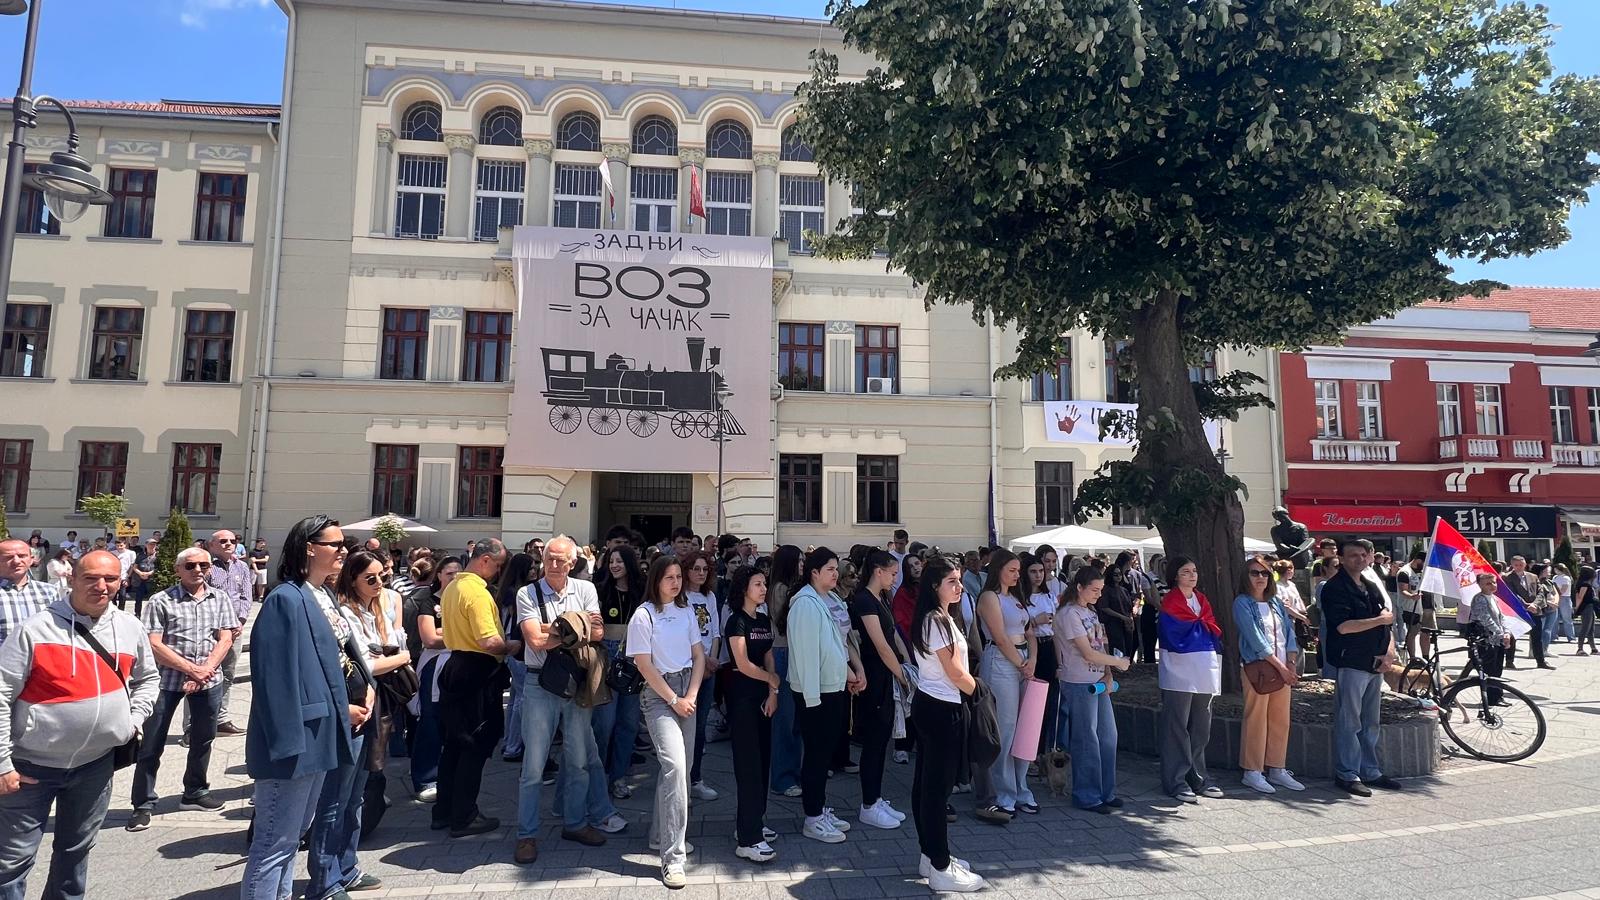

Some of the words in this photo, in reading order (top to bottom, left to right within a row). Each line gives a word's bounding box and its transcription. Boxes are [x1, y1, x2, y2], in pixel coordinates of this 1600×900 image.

[594, 233, 683, 252] ЗАДЊИ
[574, 262, 712, 309] ВОЗ
[579, 303, 611, 328] ЗА
[630, 306, 703, 332] ЧАЧАК
[1454, 508, 1530, 536] Elipsa
